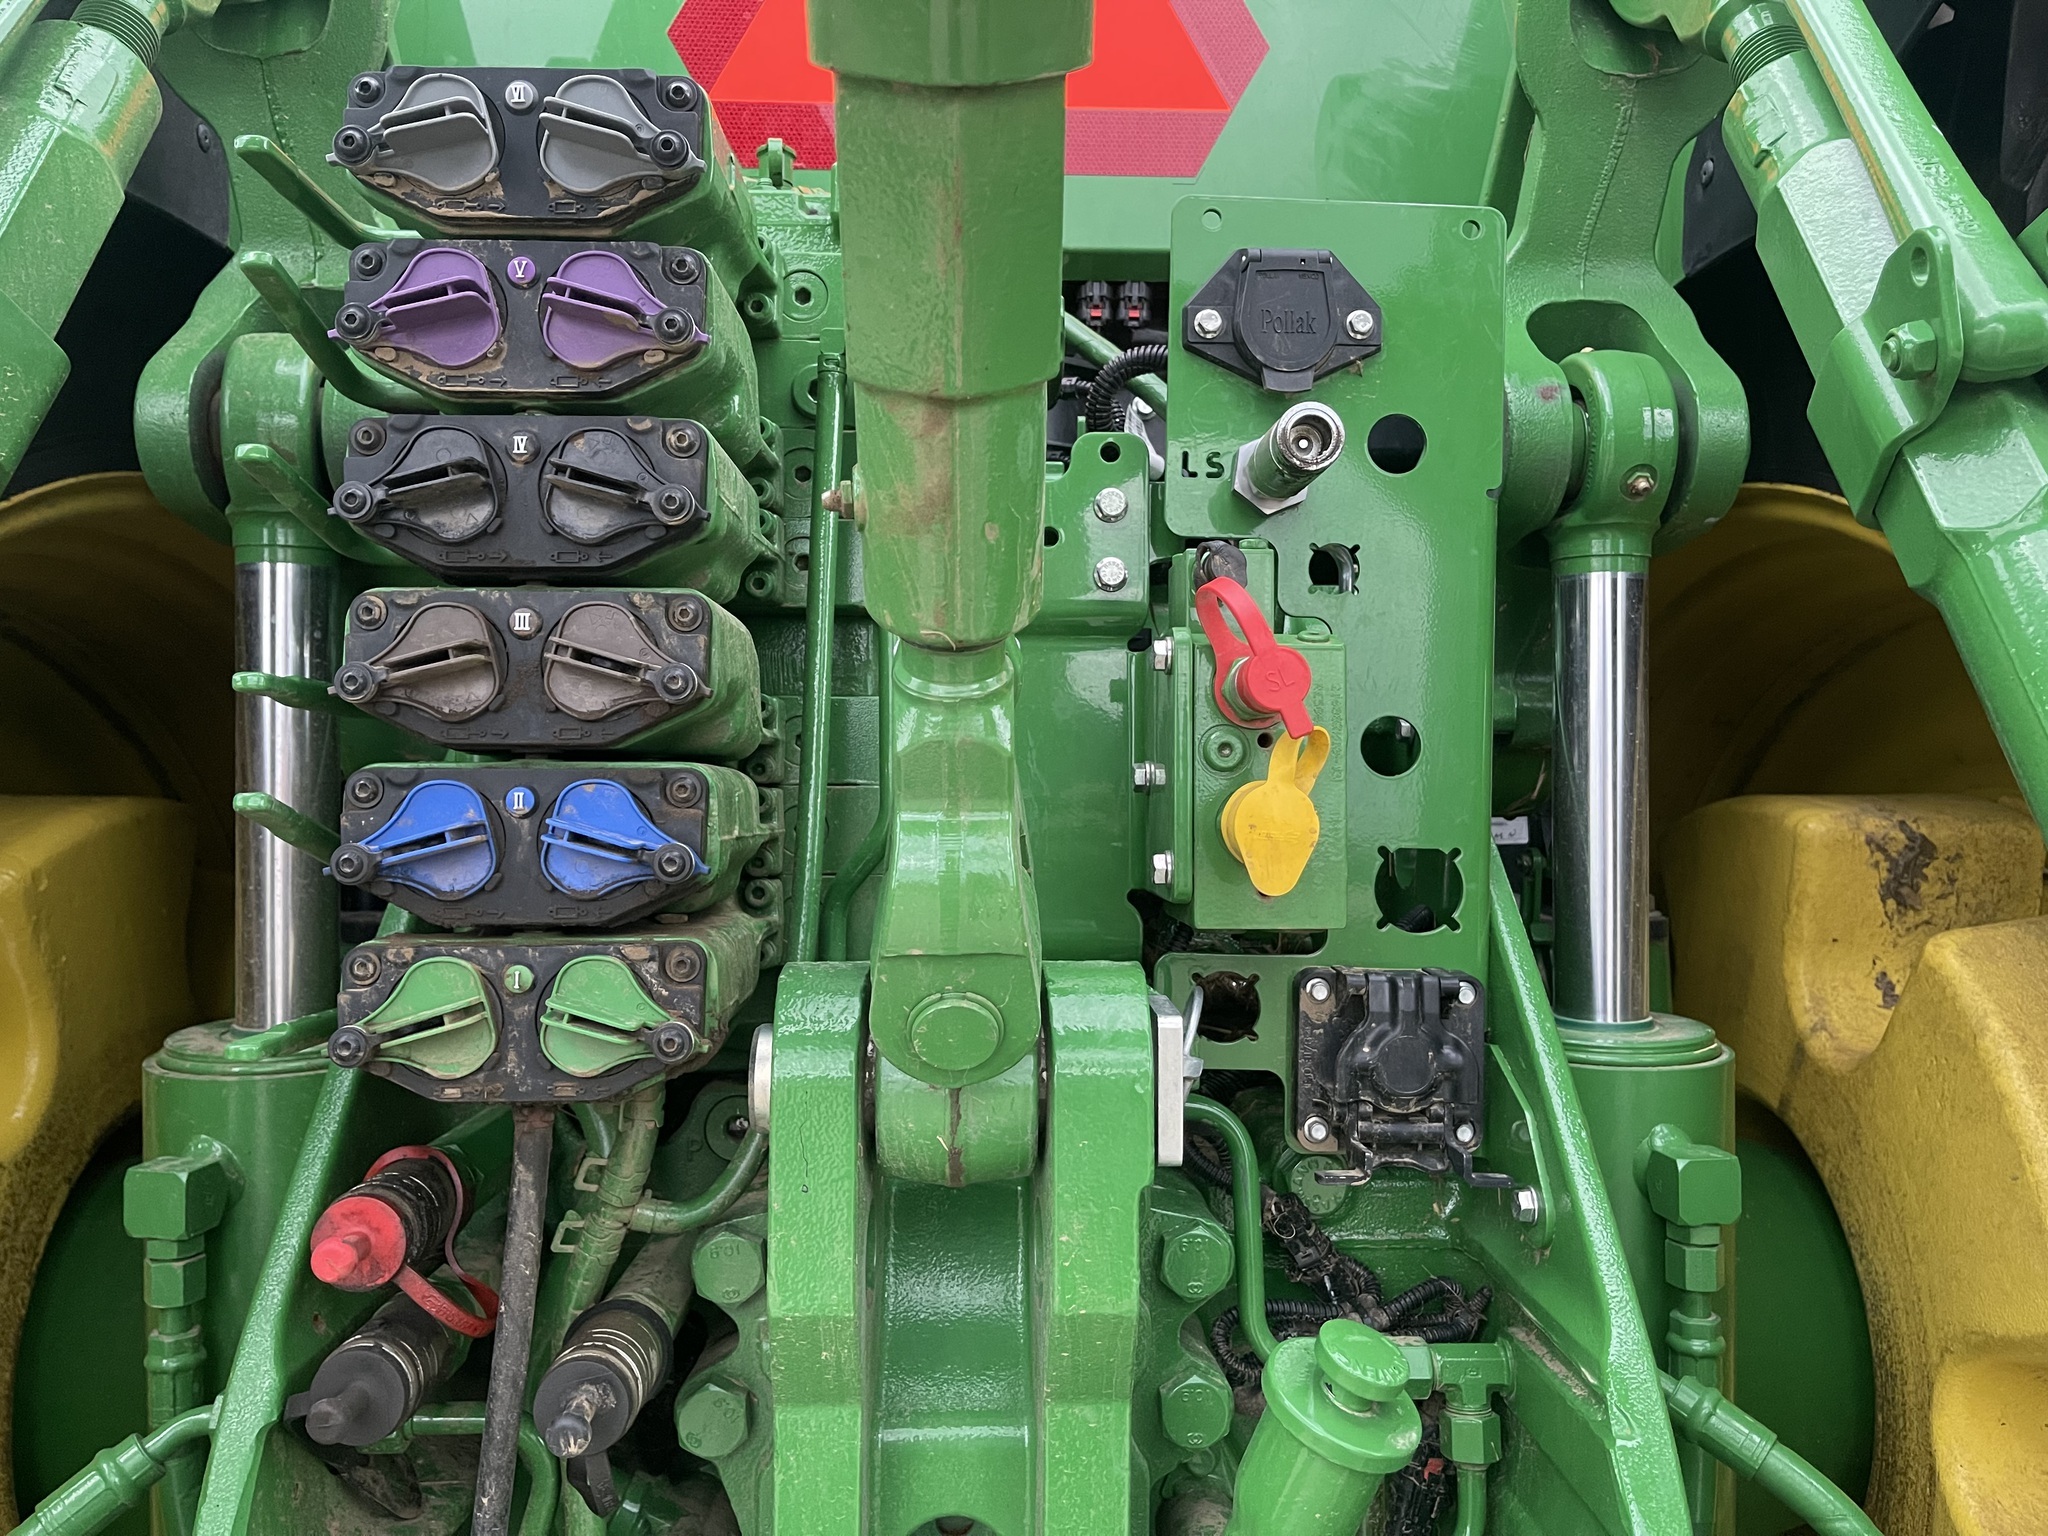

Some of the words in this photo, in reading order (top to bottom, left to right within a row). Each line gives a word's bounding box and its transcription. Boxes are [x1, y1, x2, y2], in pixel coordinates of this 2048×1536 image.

[510, 84, 526, 103] VI
[513, 260, 528, 278] V
[1260, 308, 1317, 334] Pollak
[512, 435, 528, 454] IV
[1181, 450, 1225, 479] LS
[513, 612, 531, 631] III
[1264, 667, 1296, 693] SL
[513, 791, 525, 810] II
[513, 970, 520, 989] I
